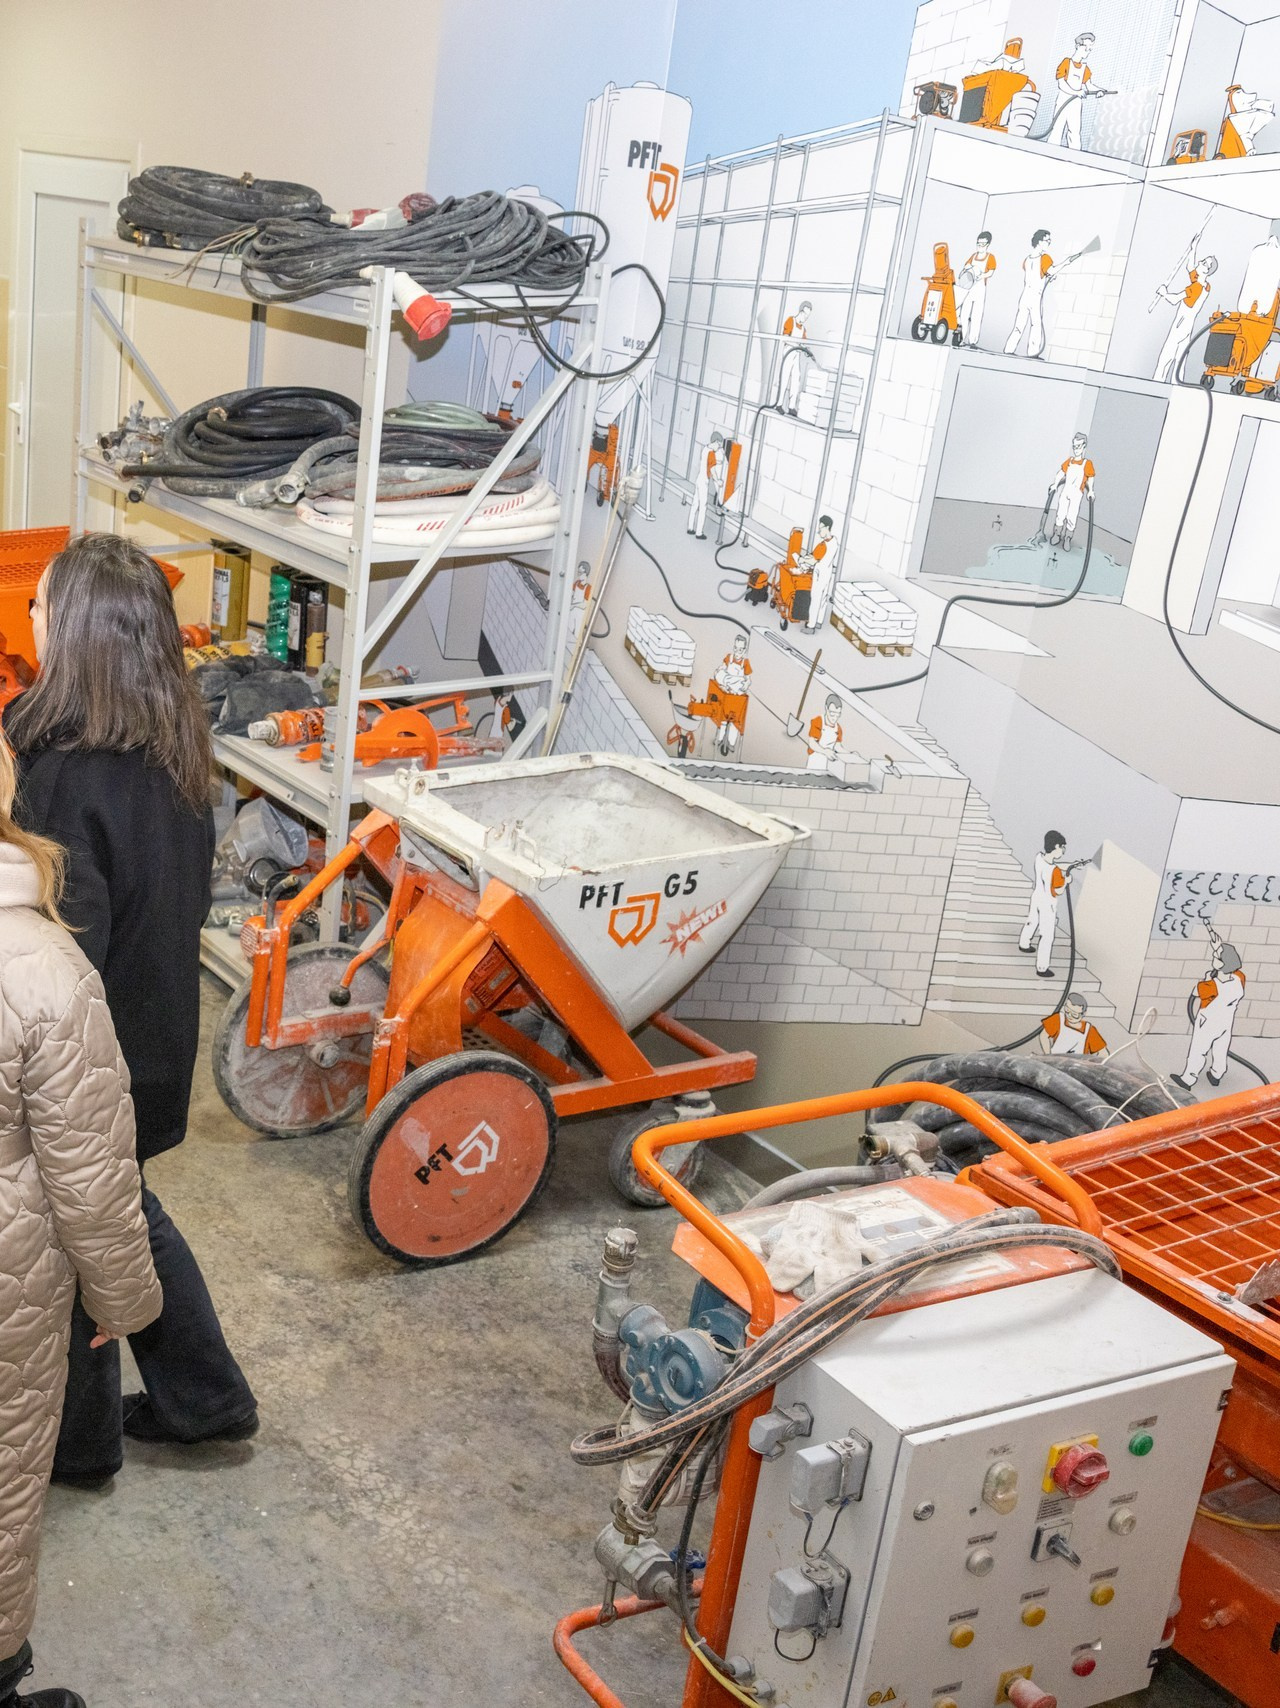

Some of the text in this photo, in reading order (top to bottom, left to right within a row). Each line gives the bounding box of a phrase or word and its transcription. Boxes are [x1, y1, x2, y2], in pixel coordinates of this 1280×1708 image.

[627, 140, 662, 171] PFT
[579, 870, 699, 910] PFT G5
[414, 1143, 453, 1185] PFT
